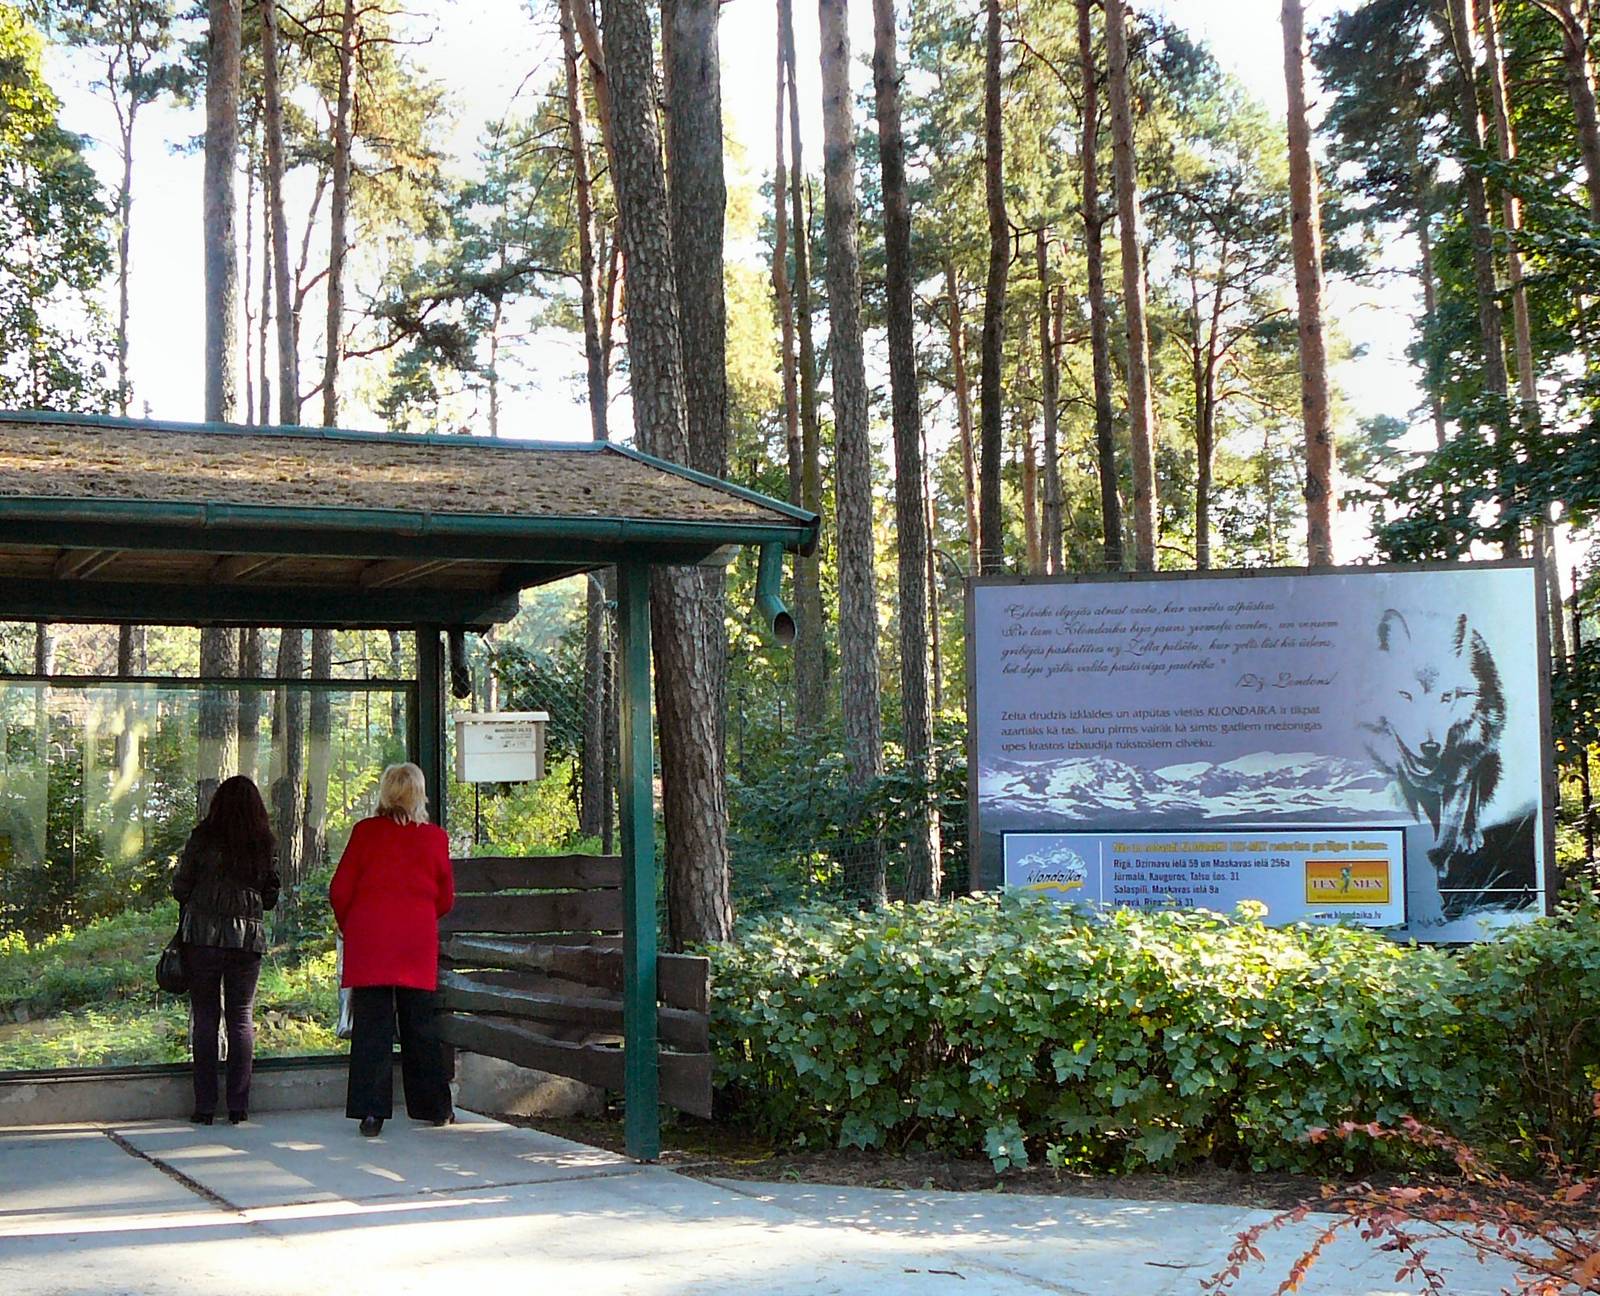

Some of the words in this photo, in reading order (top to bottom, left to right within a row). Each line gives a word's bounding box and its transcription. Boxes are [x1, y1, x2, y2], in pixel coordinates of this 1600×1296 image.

[1094, 605, 1128, 615] atrast
[1164, 601, 1184, 613] kur
[1030, 626, 1052, 636] tam
[1130, 621, 1152, 638] bija
[1153, 624, 1185, 637] jauns
[1279, 621, 1295, 630] un
[1107, 646, 1121, 657] uz
[1124, 638, 1160, 656] Zelta
[1209, 638, 1229, 650] kur
[1281, 637, 1295, 648] kā
[1002, 661, 1020, 674] bet
[1001, 711, 1026, 721] Zelta
[1029, 710, 1066, 721] drudzis
[1069, 709, 1113, 720] izklaides
[1116, 710, 1129, 719] un
[1132, 709, 1170, 721] atpūtas
[1174, 707, 1204, 717] vietās
[1207, 705, 1276, 717] KLONDAIKA
[1280, 705, 1287, 715] ir
[1290, 705, 1321, 717] tikpat
[1046, 724, 1058, 735] kā
[1082, 724, 1105, 734] kuru
[1107, 723, 1138, 737] pirms
[1141, 722, 1172, 733] vairāk
[1174, 722, 1187, 732] kā
[1190, 721, 1218, 732] simts
[1221, 720, 1261, 734] gadiem
[1001, 742, 1026, 753] upes
[1029, 740, 1065, 751] krastos
[1067, 739, 1113, 752] izbaudīja
[1116, 738, 1172, 750] tūkstošiem
[1135, 858, 1170, 868] Dzirnavu
[1172, 858, 1187, 868] ielā
[1188, 859, 1199, 868] 59
[1201, 860, 1210, 868] un
[1213, 858, 1252, 868] Maskavas
[1254, 858, 1269, 868] ielā
[1270, 858, 1290, 868] 256a
[1027, 869, 1082, 884] klondaika
[1190, 872, 1210, 881] Talsu
[1230, 871, 1240, 881] 31
[1152, 884, 1191, 894] Maskavas
[1193, 884, 1207, 894] ielā
[1209, 885, 1219, 894] 9a
[1312, 879, 1336, 890] TEX
[1353, 879, 1383, 890] MEX
[1184, 897, 1194, 907] 31
